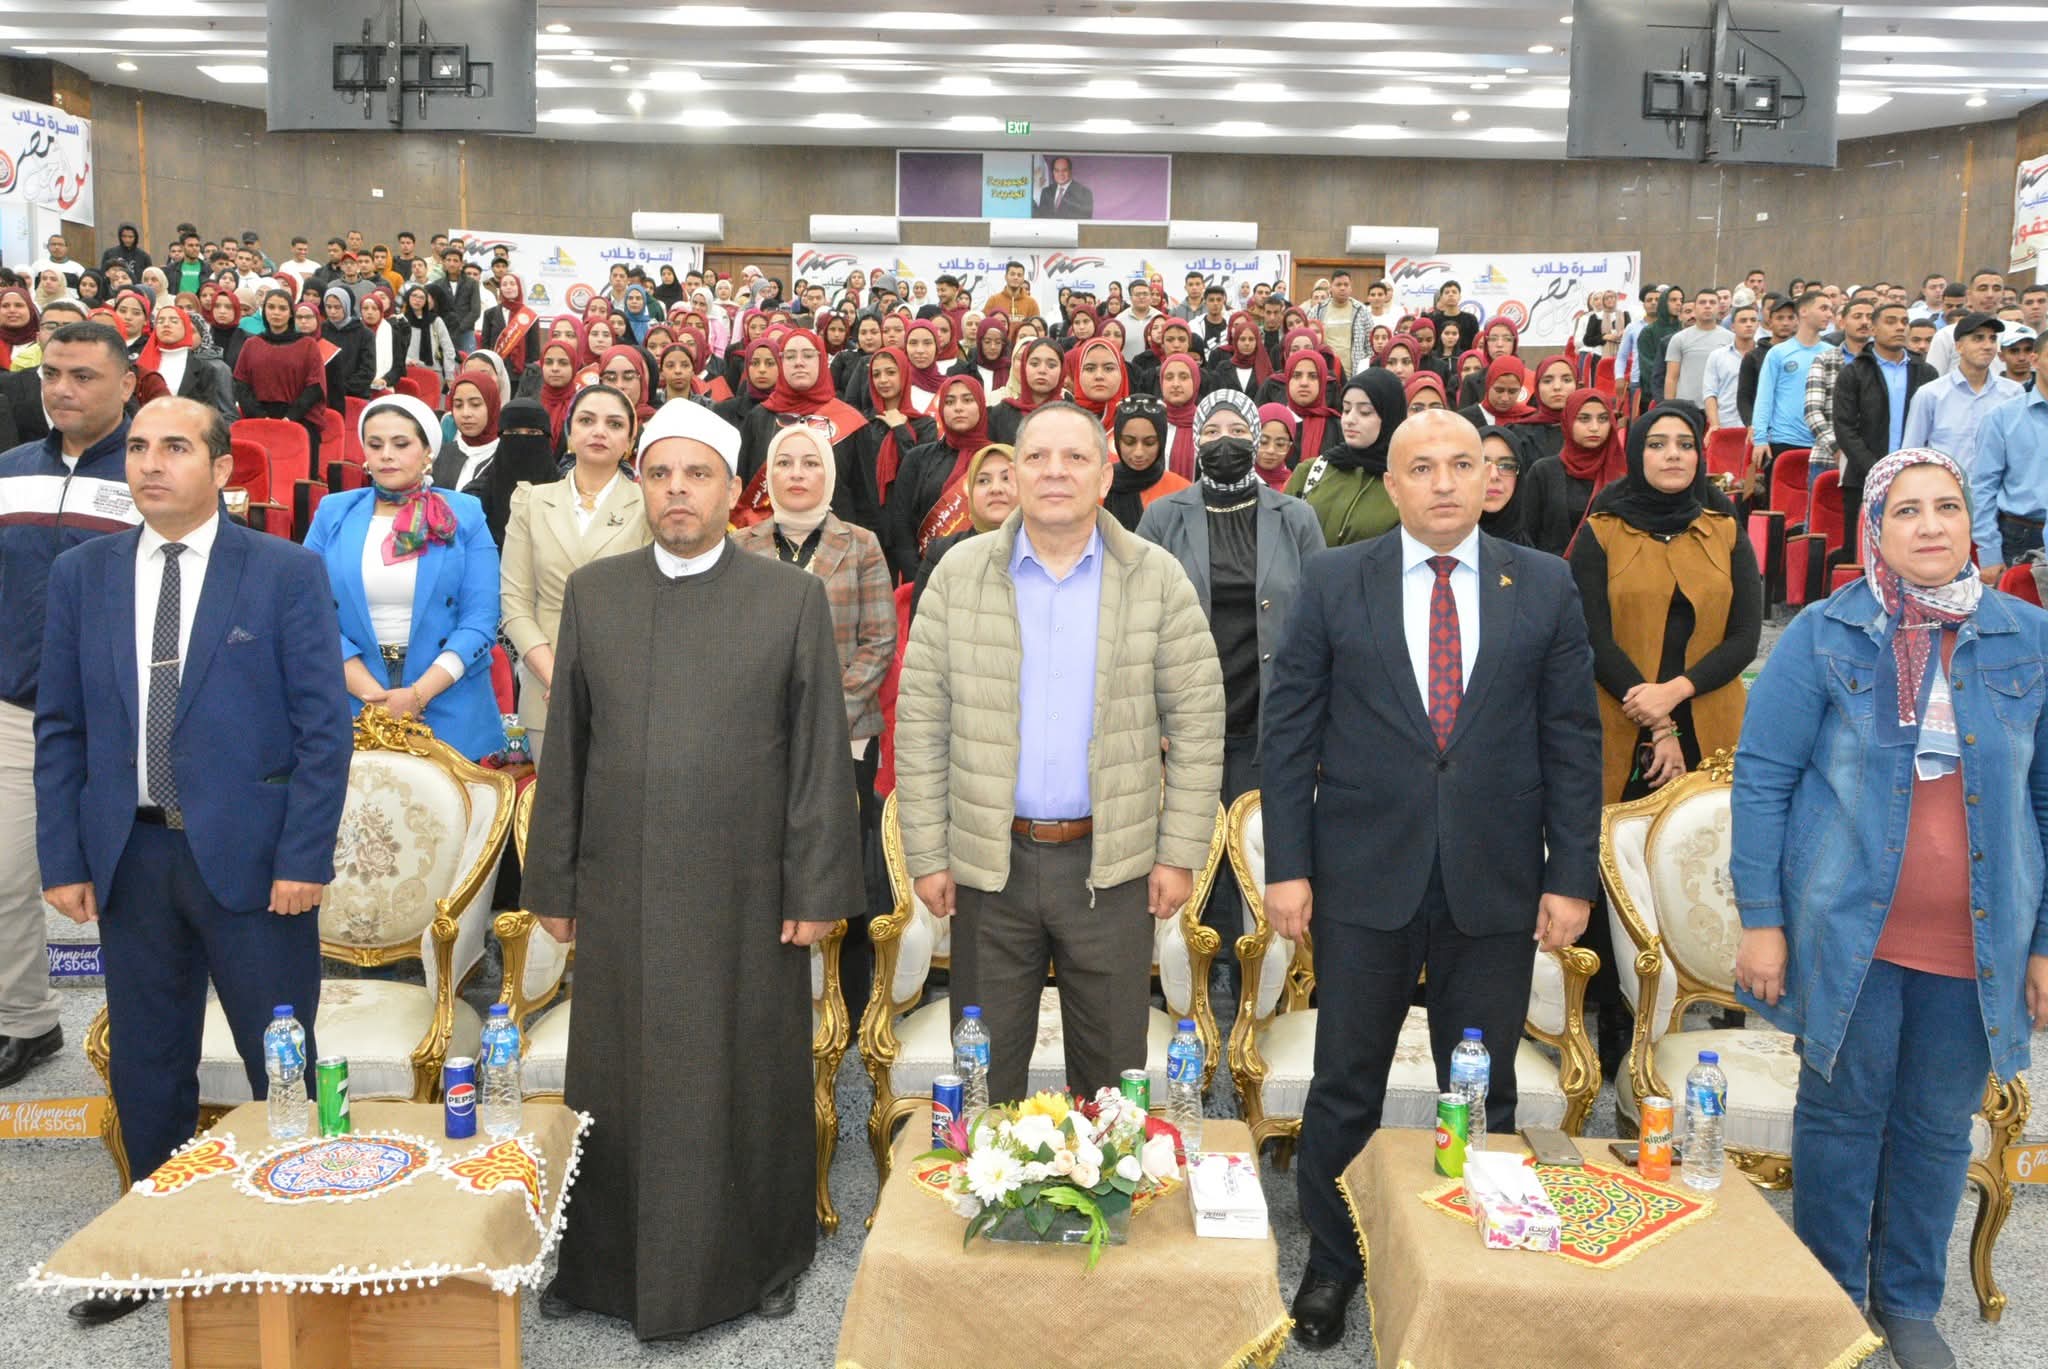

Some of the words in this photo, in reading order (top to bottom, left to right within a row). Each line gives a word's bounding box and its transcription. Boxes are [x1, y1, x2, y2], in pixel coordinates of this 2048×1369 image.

[12, 109, 46, 127] طلاب
[1007, 121, 1029, 134] EXIT
[600, 246, 635, 261] طلاب
[638, 246, 673, 263] أسرة
[938, 257, 975, 273] طلاب
[977, 256, 1012, 273] سرة
[1185, 257, 1222, 271] طلاب
[1224, 256, 1259, 273] أسرة
[1532, 261, 1569, 278] طلاب
[1571, 258, 1608, 276] أسرة
[51, 958, 100, 973] A-SDGs)
[448, 1094, 475, 1104] PEPS
[15, 1103, 88, 1121] Olympiad
[1644, 1132, 1673, 1145] MIRIND
